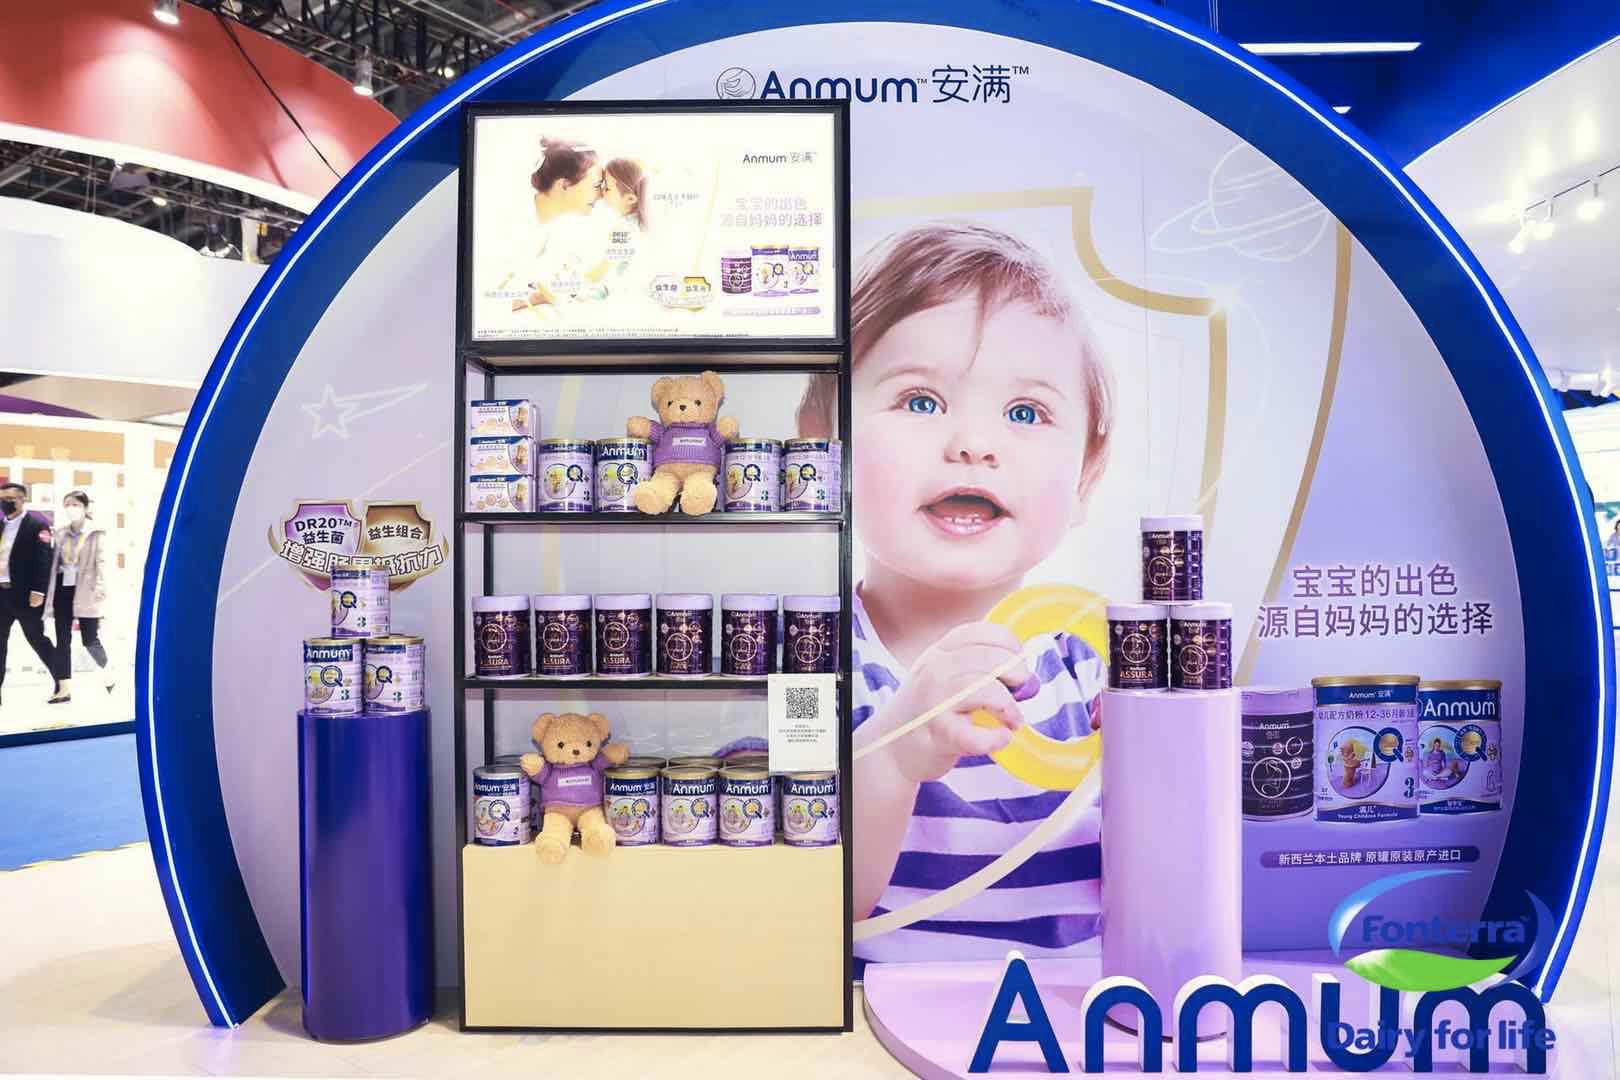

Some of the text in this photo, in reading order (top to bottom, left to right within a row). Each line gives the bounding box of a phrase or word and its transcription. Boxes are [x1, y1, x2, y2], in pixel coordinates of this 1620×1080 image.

[302, 530, 344, 545] 益生菌
[368, 524, 423, 540] 益生组合
[1293, 563, 1458, 598] 宝宝的出色
[1258, 602, 1493, 638] 源自妈妈的选择
[1424, 699, 1496, 717] Anmum
[1279, 849, 1461, 865] 新西兰本土品牌 原罐原装原产进口
[968, 949, 1547, 1074] Anmum
